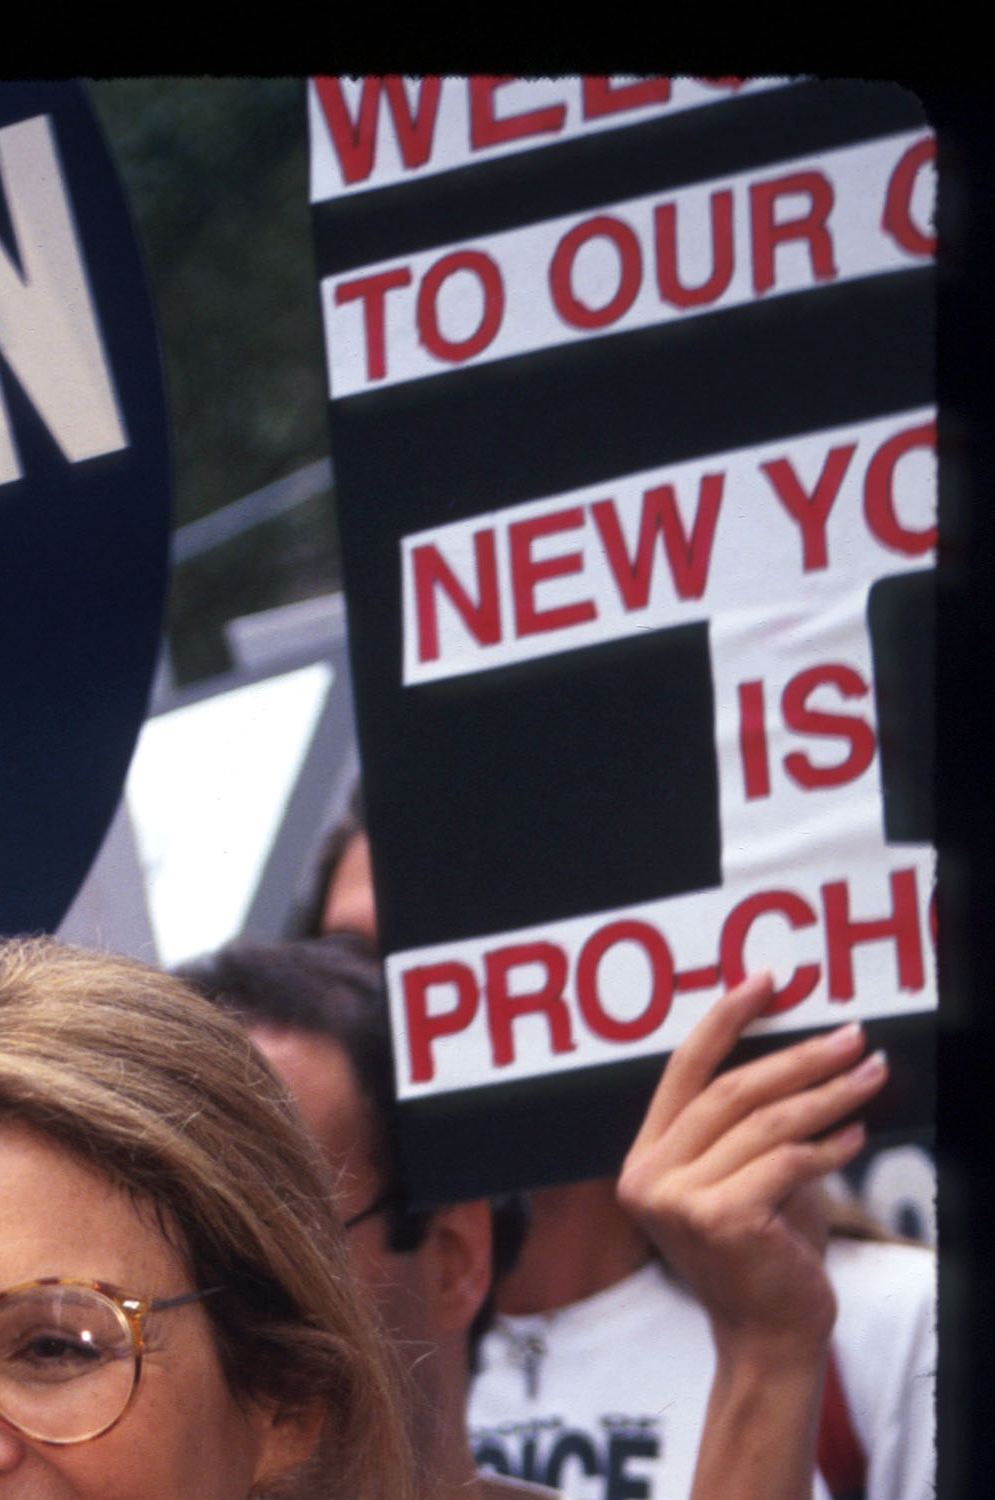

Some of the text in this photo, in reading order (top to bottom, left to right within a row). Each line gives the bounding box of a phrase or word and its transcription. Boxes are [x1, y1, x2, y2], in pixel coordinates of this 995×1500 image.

[334, 250, 505, 381] TO
[548, 169, 838, 330] OUR
[411, 471, 726, 665] NEW
[737, 663, 877, 801] IS
[399, 866, 938, 1086] PRO-CH
